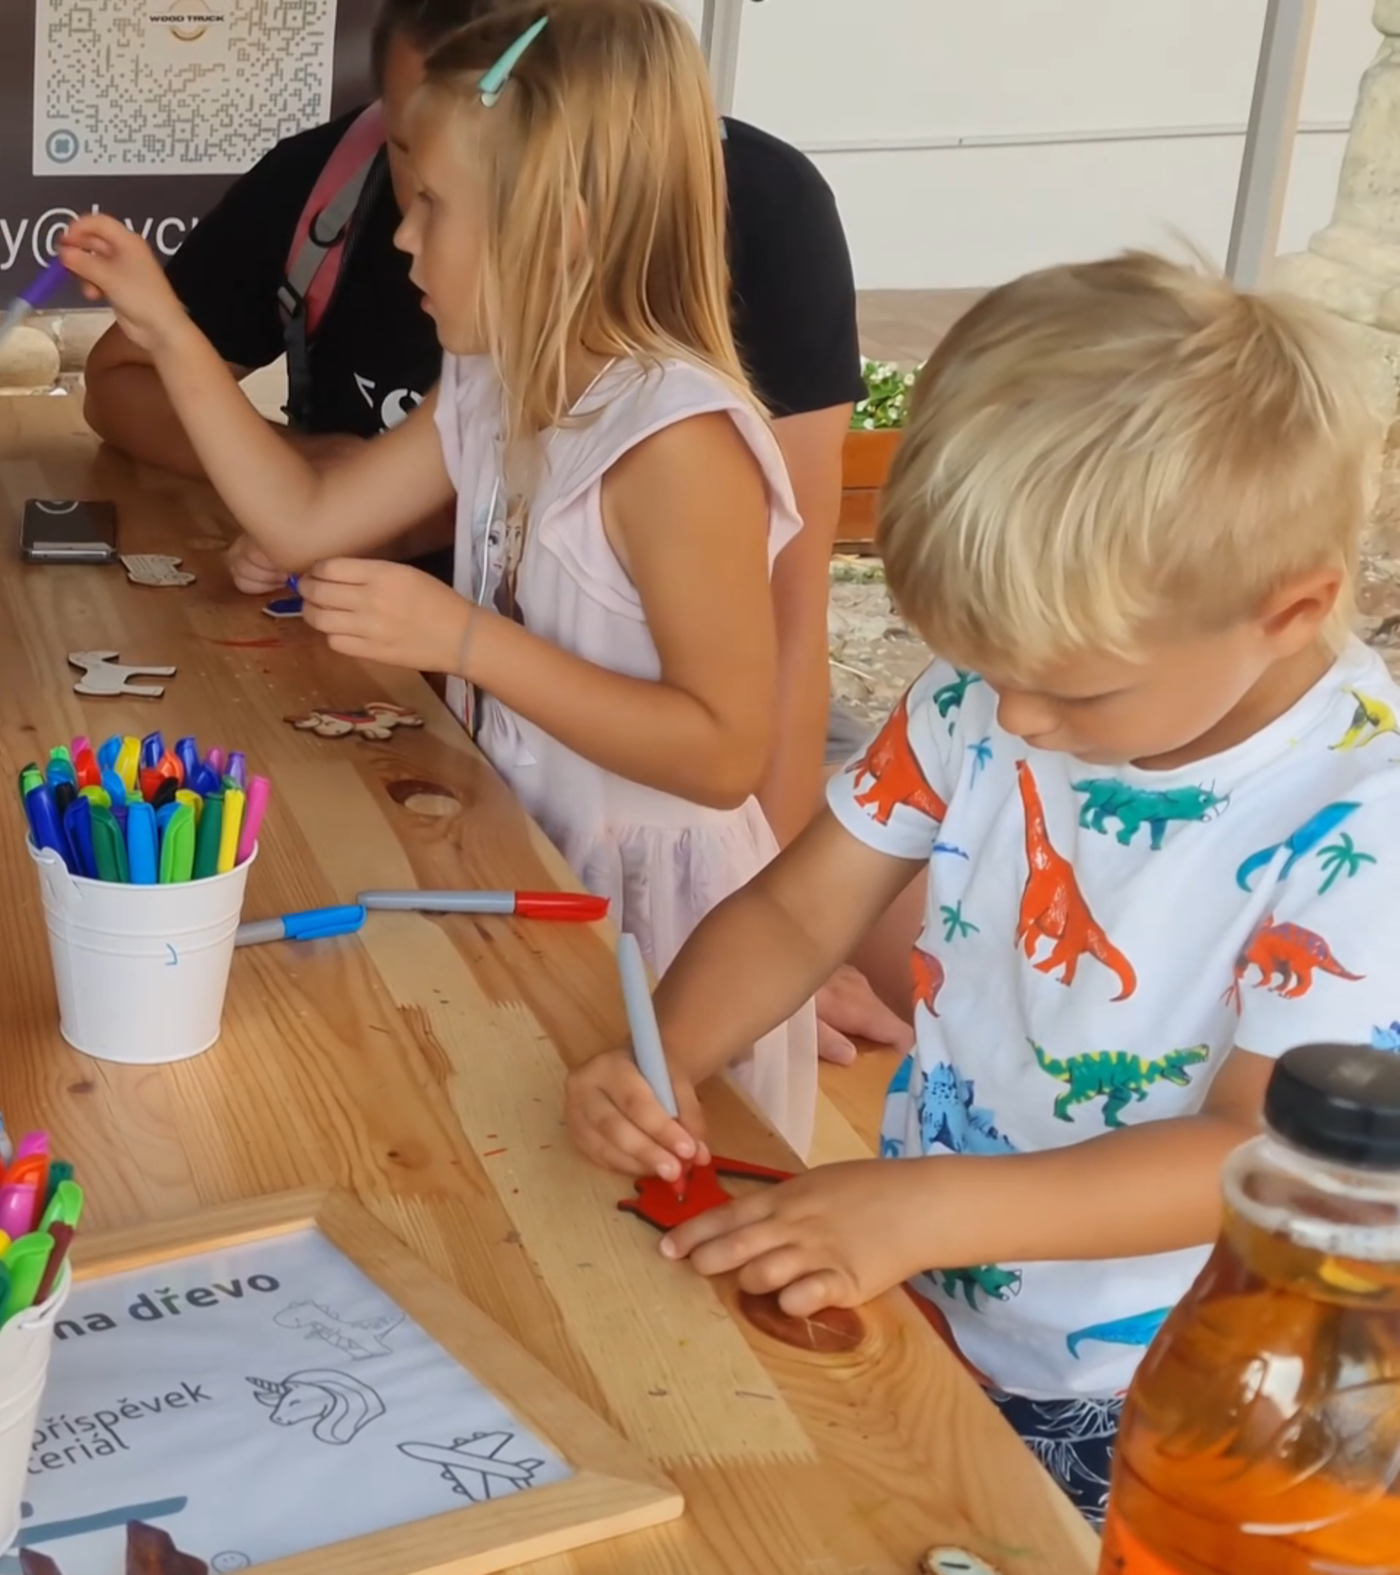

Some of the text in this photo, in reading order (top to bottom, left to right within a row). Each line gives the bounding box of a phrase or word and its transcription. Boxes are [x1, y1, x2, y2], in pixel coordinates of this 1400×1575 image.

[149, 14, 225, 23] WOOD TRUCK
[52, 1273, 281, 1341] na dřevo
